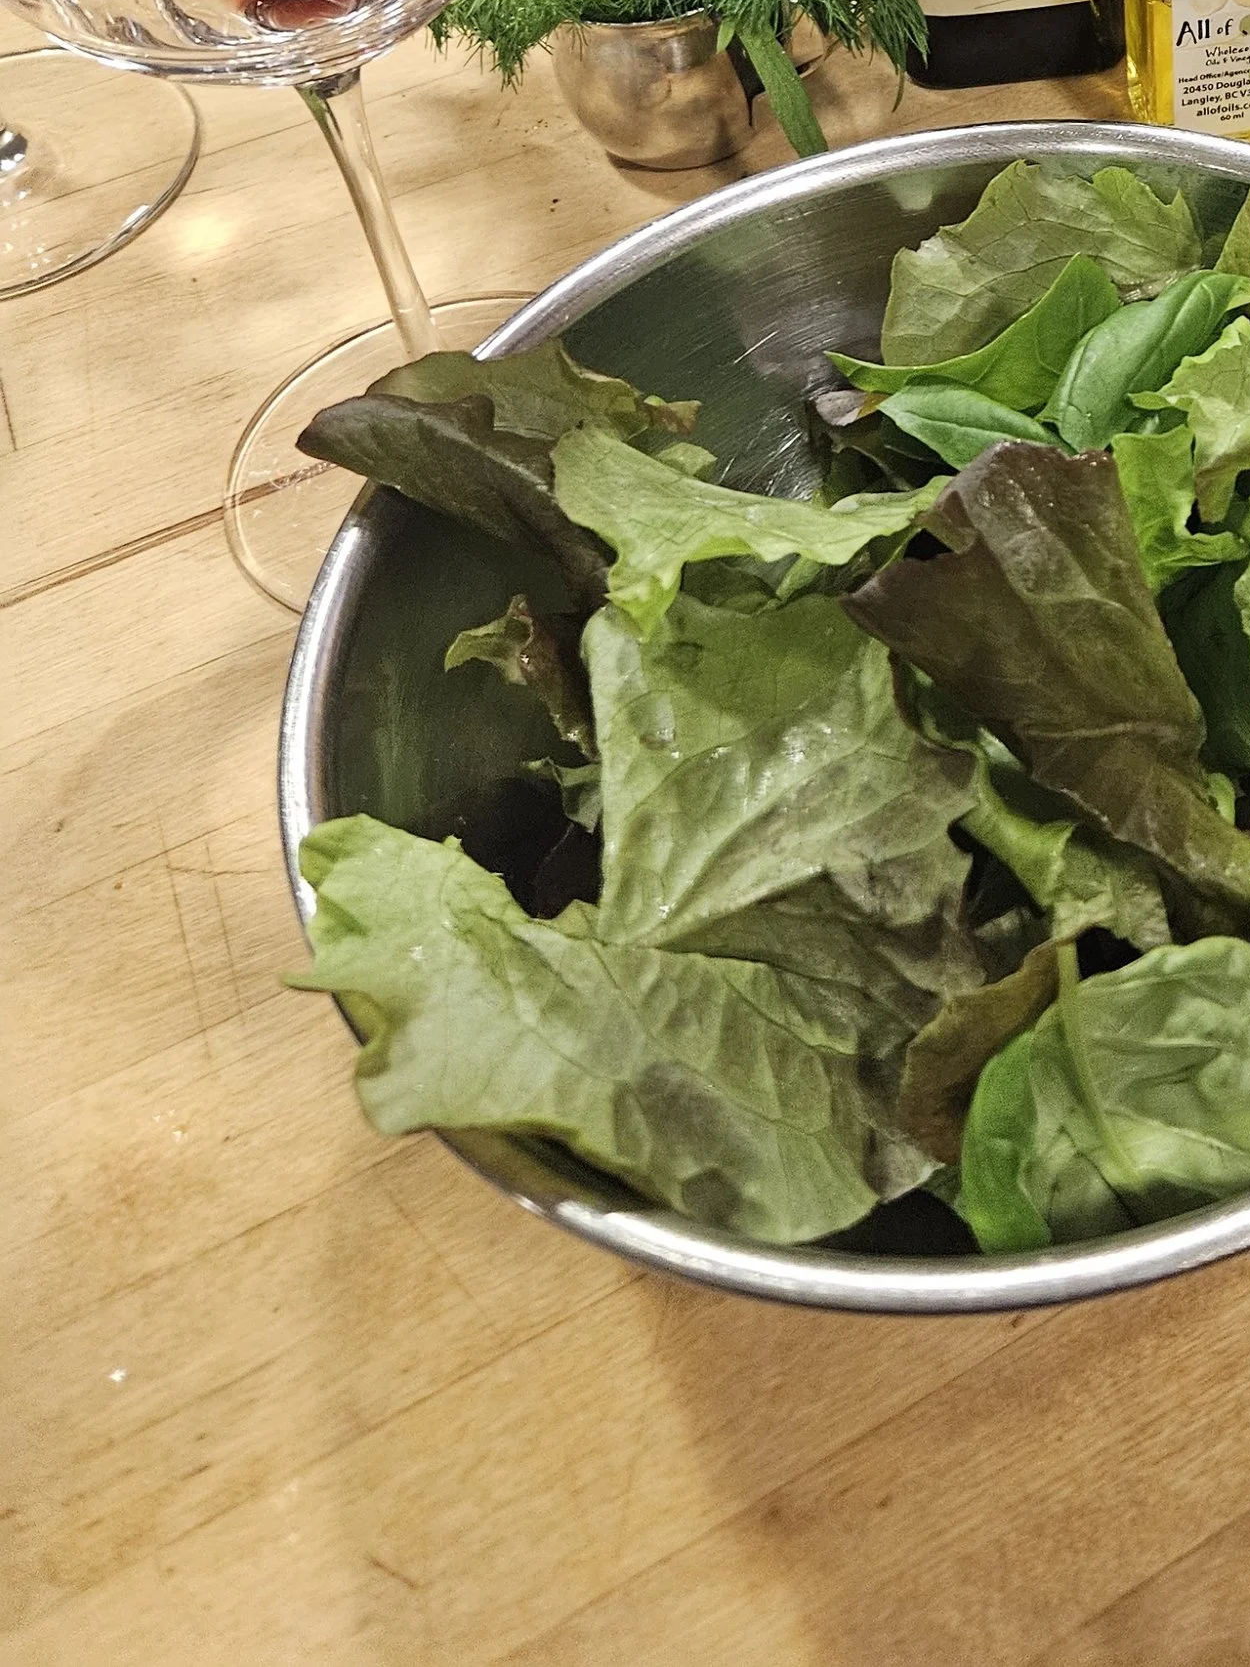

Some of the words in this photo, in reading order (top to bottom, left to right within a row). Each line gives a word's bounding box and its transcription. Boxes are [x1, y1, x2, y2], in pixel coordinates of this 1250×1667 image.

[1176, 18, 1211, 47] All
[1216, 18, 1234, 36] of
[1178, 75, 1199, 84] Head
[1183, 83, 1214, 95] 20450
[1181, 93, 1223, 108] Langley,
[1225, 90, 1238, 99] BC
[1220, 114, 1232, 122] 60
[1233, 111, 1245, 120] ml
